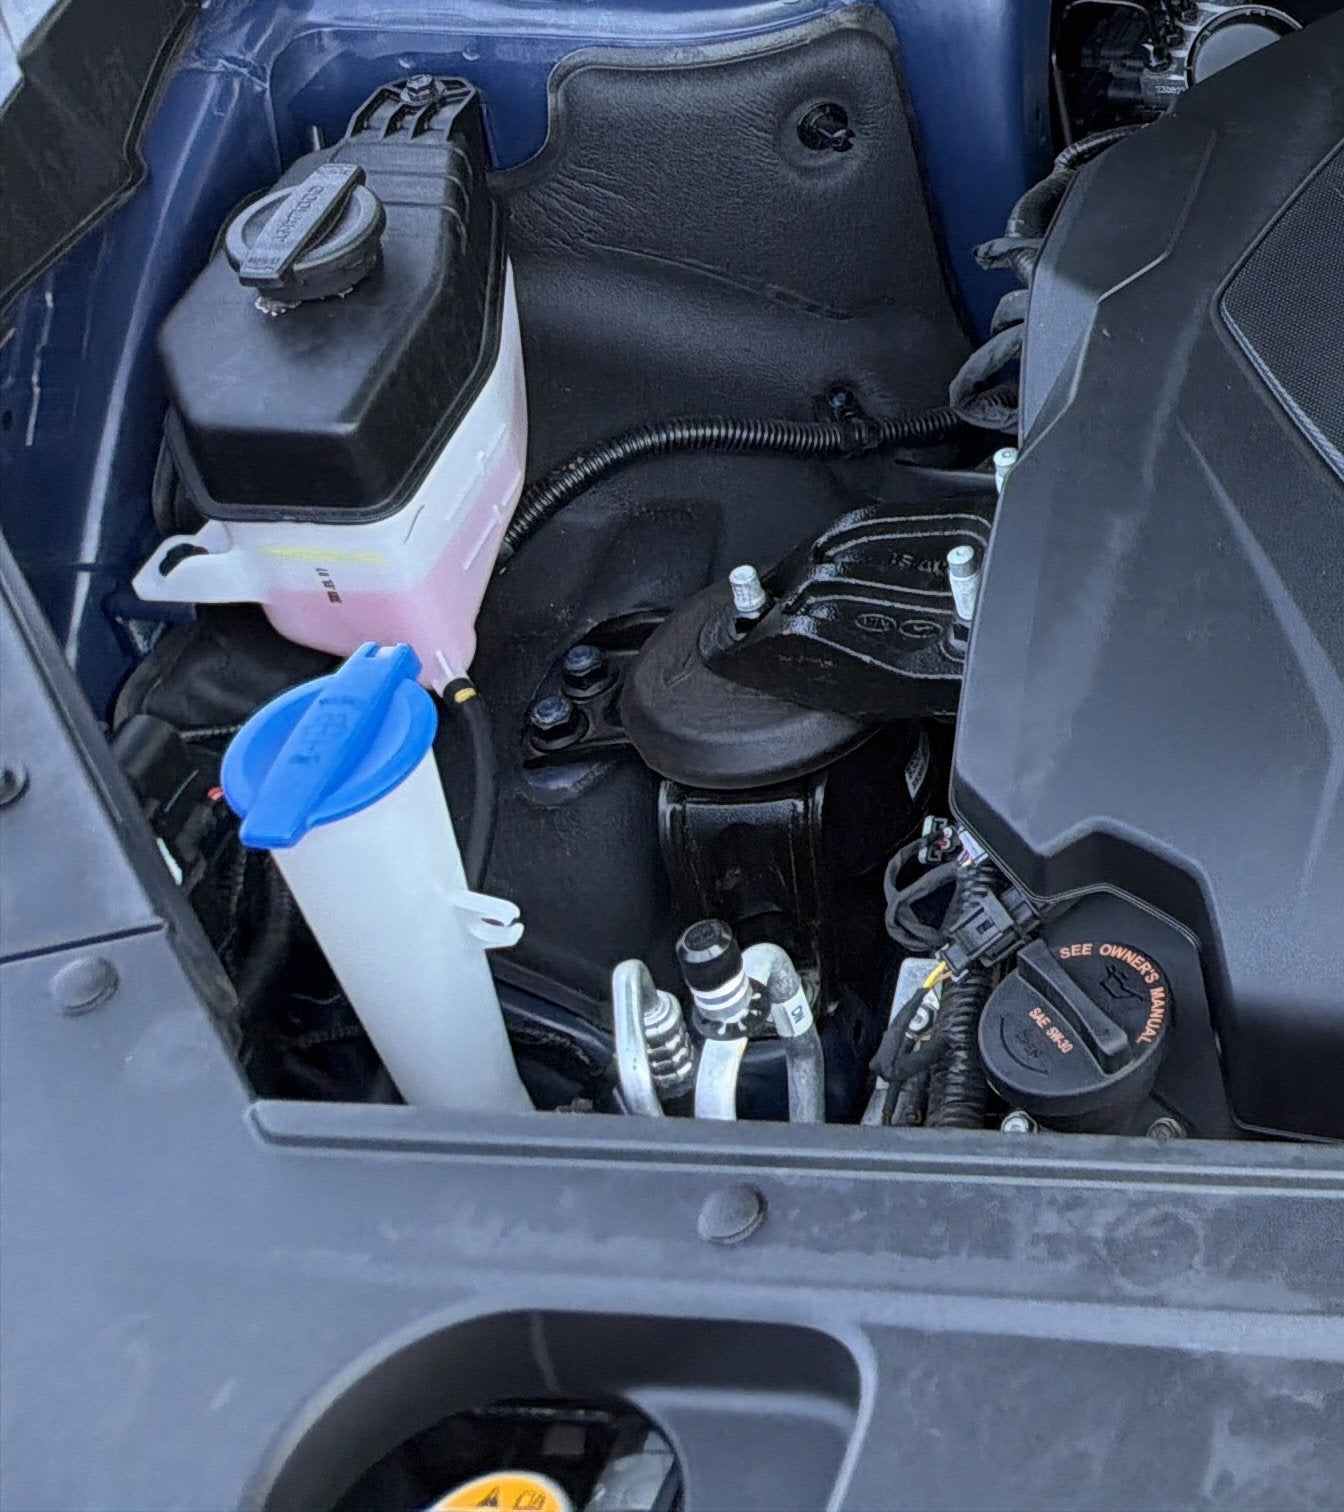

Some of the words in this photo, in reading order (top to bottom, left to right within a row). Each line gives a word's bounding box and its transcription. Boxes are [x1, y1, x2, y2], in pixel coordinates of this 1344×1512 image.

[1028, 1006, 1051, 1029] SAE
[1045, 1026, 1074, 1054] 5W-30
[1059, 943, 1093, 960] SEE
[1099, 943, 1160, 985] OWNER'S
[1135, 987, 1166, 1045] MANUAL
